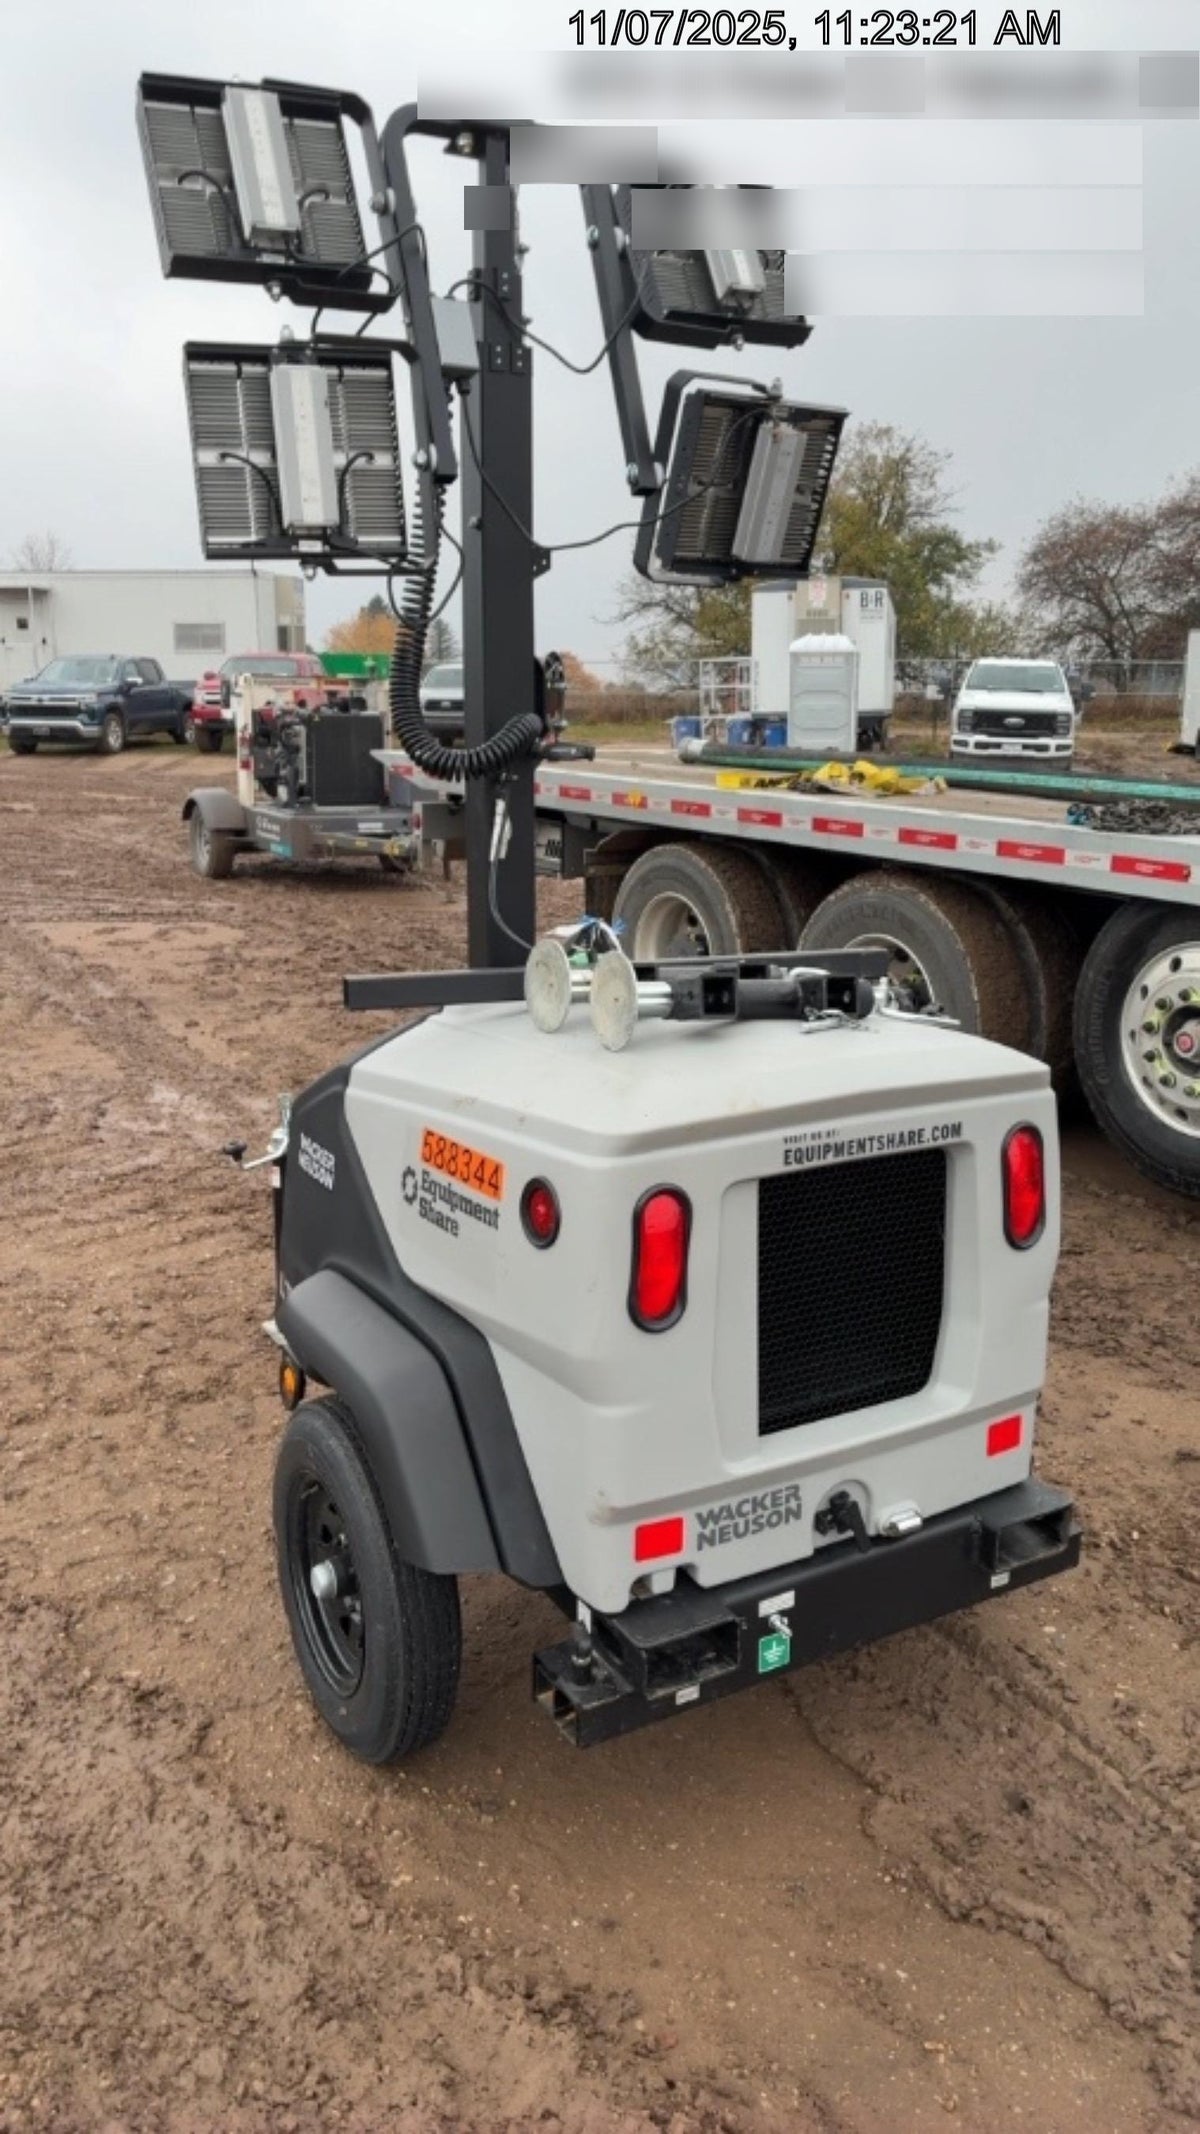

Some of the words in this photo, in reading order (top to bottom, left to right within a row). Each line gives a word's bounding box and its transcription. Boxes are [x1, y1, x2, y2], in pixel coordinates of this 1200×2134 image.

[422, 1130, 501, 1196] 588344
[783, 1121, 963, 1167] EQUIPMENTSHARE.COM
[419, 1197, 459, 1237] Share
[421, 1169, 500, 1232] Equipment
[695, 1484, 801, 1531] WACKER
[696, 1502, 802, 1552] NEUSON
